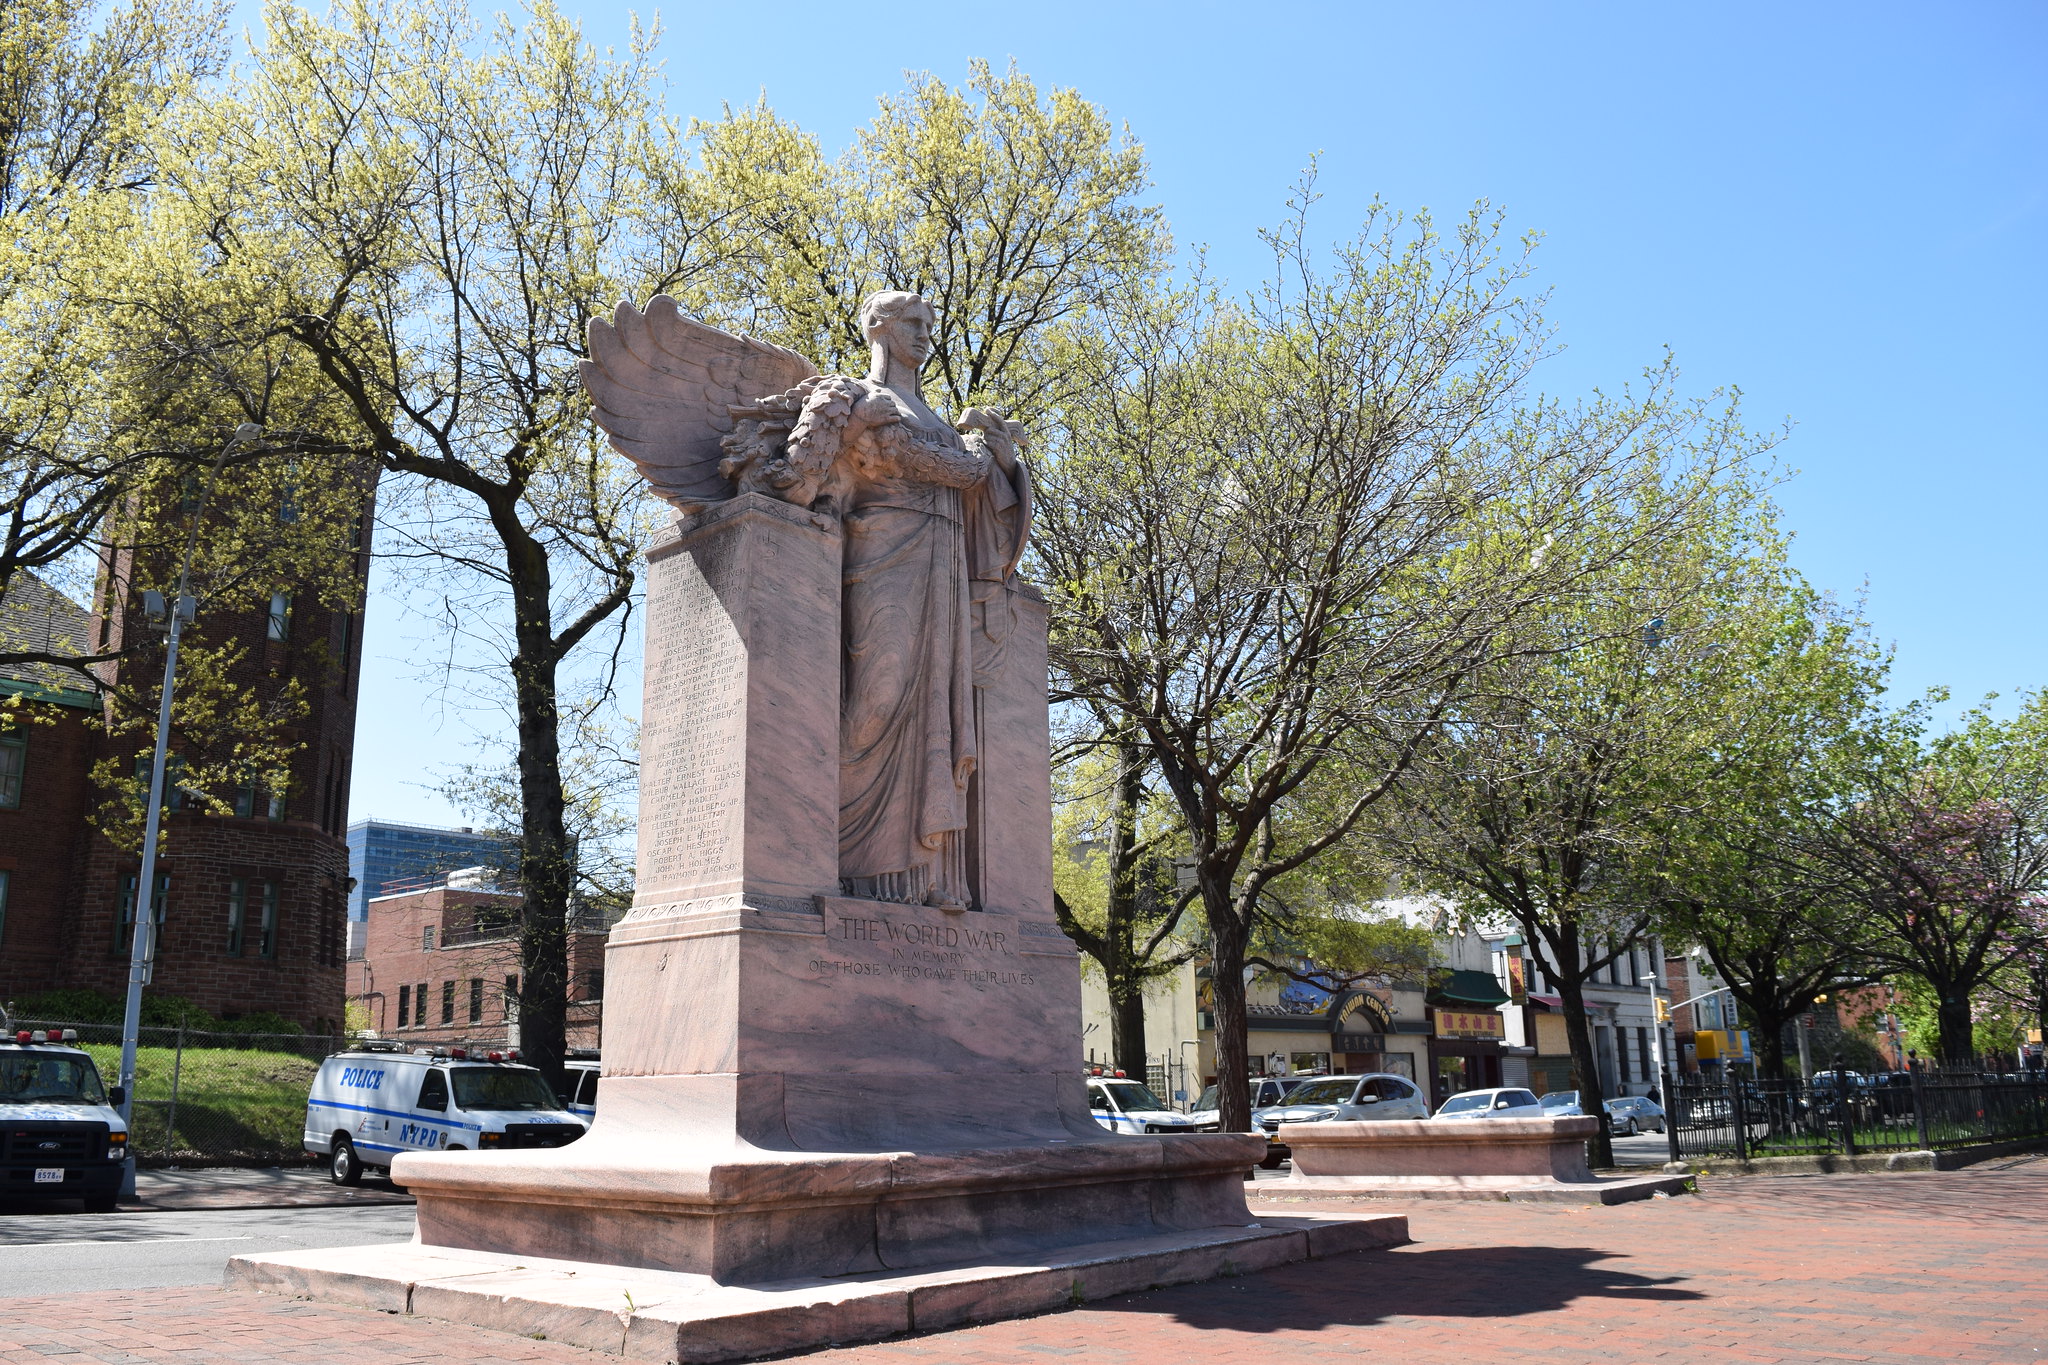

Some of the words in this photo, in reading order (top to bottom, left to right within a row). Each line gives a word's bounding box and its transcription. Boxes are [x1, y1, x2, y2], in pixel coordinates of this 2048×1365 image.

[648, 592, 674, 606] ROBERT
[716, 567, 746, 583] BEAVER
[660, 575, 699, 594] FREDERICK
[652, 606, 682, 621] TIMOTHY
[657, 598, 681, 611] JAMES
[658, 614, 682, 627] JAMES
[661, 619, 690, 634] EDWARD
[649, 631, 680, 646] VINCENT
[684, 624, 701, 635] PAUL
[659, 637, 689, 651] WILLIAM
[701, 623, 732, 638] COLLINS
[664, 644, 691, 658] JOSEPH
[702, 633, 726, 646] CRAIK
[645, 658, 672, 672] VINCENT
[677, 646, 714, 662] AUGUSTINE
[660, 659, 697, 676] VINCENZO
[644, 673, 680, 689] FREDERICK
[684, 664, 708, 677] JOSEPH
[712, 653, 744, 669] DONDERO
[653, 682, 677, 694] JAMES
[680, 673, 708, 686] SUYDAM
[711, 665, 734, 677] EADIE
[650, 698, 680, 712] WILLIAM
[685, 687, 717, 702] SPENCER
[723, 682, 737, 691] ELY
[687, 696, 719, 710] EMMONS
[643, 717, 671, 731] WILLIAM
[681, 701, 729, 720] ESPENSCHEID
[648, 725, 672, 738] GRACE
[687, 708, 737, 727] FALKENBERG
[673, 729, 691, 739] JOHN
[697, 724, 710, 733] FAY
[647, 748, 685, 763] SYLVESTER
[659, 738, 691, 752] NORBERT
[657, 756, 686, 769] GORDON
[700, 747, 725, 759] GATES
[663, 765, 687, 776] JAMES
[701, 757, 717, 767] GILL
[643, 777, 670, 790] WALTER
[677, 769, 705, 782] ERNEST
[710, 761, 740, 774] GILLAM
[673, 778, 707, 791] WALLACE
[715, 770, 741, 782] GLASS
[651, 791, 686, 805] CARMELA
[659, 802, 678, 812] JOHN
[689, 793, 719, 805] HADLEY
[640, 812, 671, 824] CHARLES
[687, 800, 726, 815] HALLBERG
[652, 819, 679, 831] ELBERT
[657, 827, 685, 839] LESTER
[647, 847, 672, 858] OSCAR
[687, 836, 730, 850] HESSINGER
[655, 836, 682, 847] JOSEPH
[698, 828, 723, 839] HENRY
[654, 854, 683, 866] ROBERT
[700, 846, 724, 857] HIGGS
[656, 864, 675, 874] JOHN
[689, 856, 721, 868] HOLMES
[638, 876, 657, 886] DAVID
[663, 869, 698, 882] RAYMOND
[703, 862, 740, 875] JACKSON
[839, 917, 880, 942] THE
[884, 919, 958, 948] WORLD
[965, 929, 1007, 956] WAR
[893, 948, 904, 960] IN
[912, 951, 966, 966] MEMORY
[809, 960, 829, 975] OF
[834, 961, 881, 976] THOSE
[887, 963, 920, 978] WHO
[924, 967, 956, 981] GAVE
[962, 969, 1000, 985] THEIR
[1002, 972, 1035, 985] LIVES
[1340, 993, 1364, 1025] TAIWAN
[1366, 995, 1390, 1026] CENTER
[340, 1068, 385, 1090] POLICE
[399, 1124, 438, 1148] NYPD
[464, 1122, 477, 1130] POLICE
